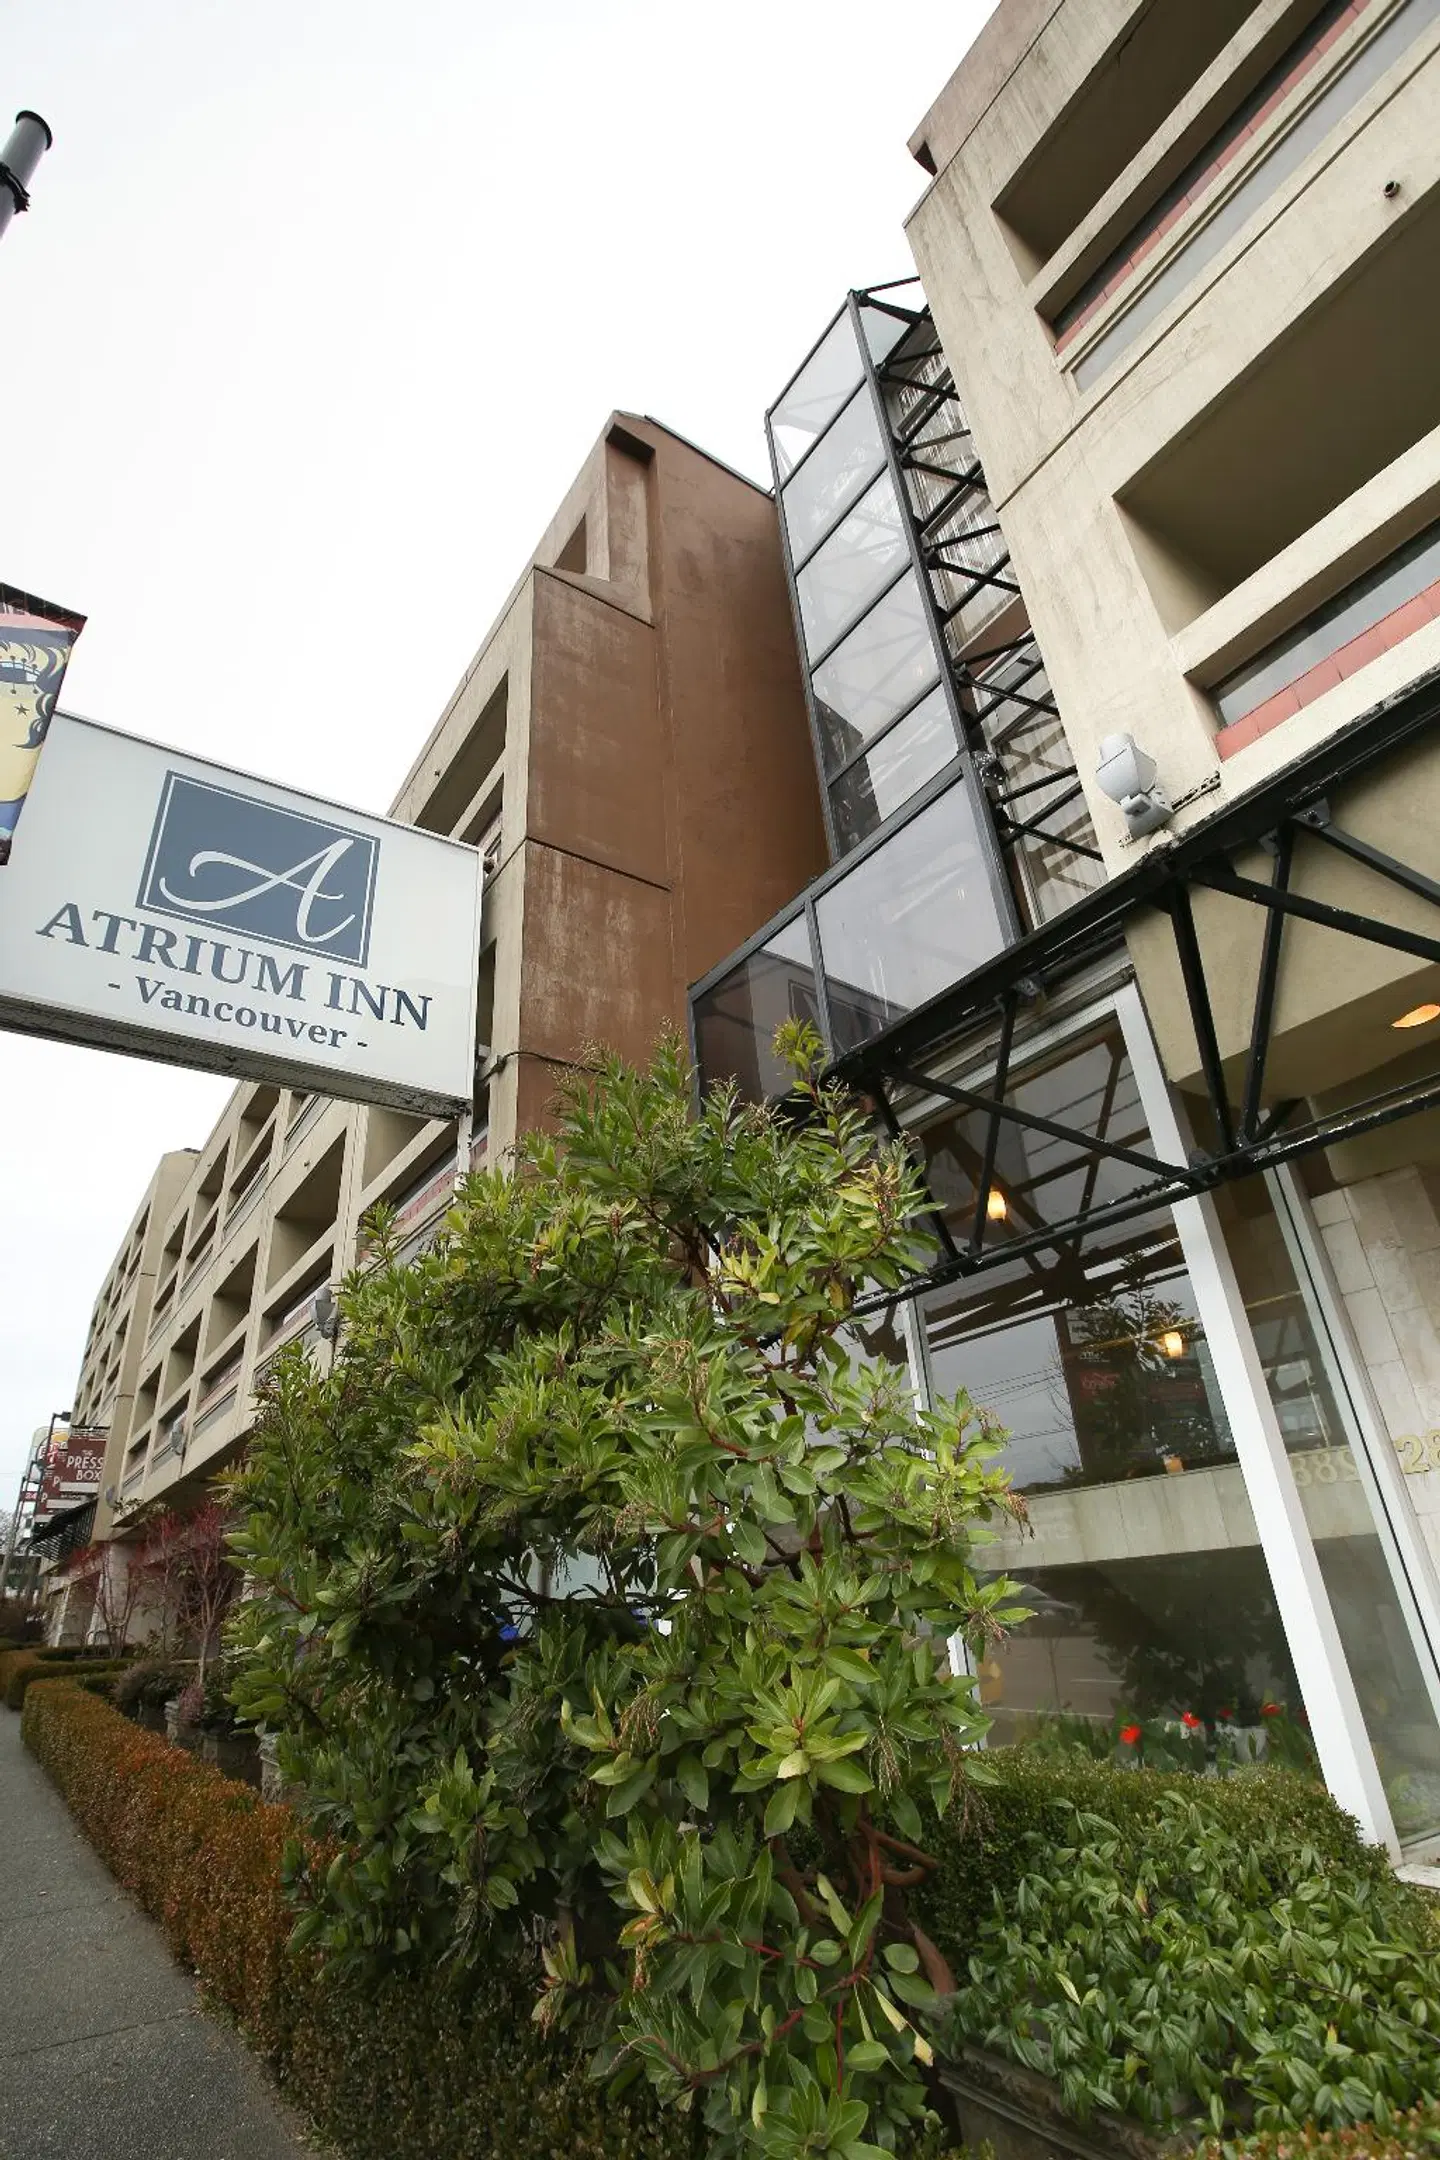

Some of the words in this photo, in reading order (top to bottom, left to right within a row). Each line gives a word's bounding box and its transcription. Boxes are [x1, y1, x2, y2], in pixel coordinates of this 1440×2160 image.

[159, 838, 356, 943] A
[36, 902, 309, 1002] ATRIUM
[323, 971, 433, 1031] INN
[135, 975, 348, 1050] Vancouver
[66, 1456, 105, 1470] PRESS
[76, 1469, 103, 1481] BOX
